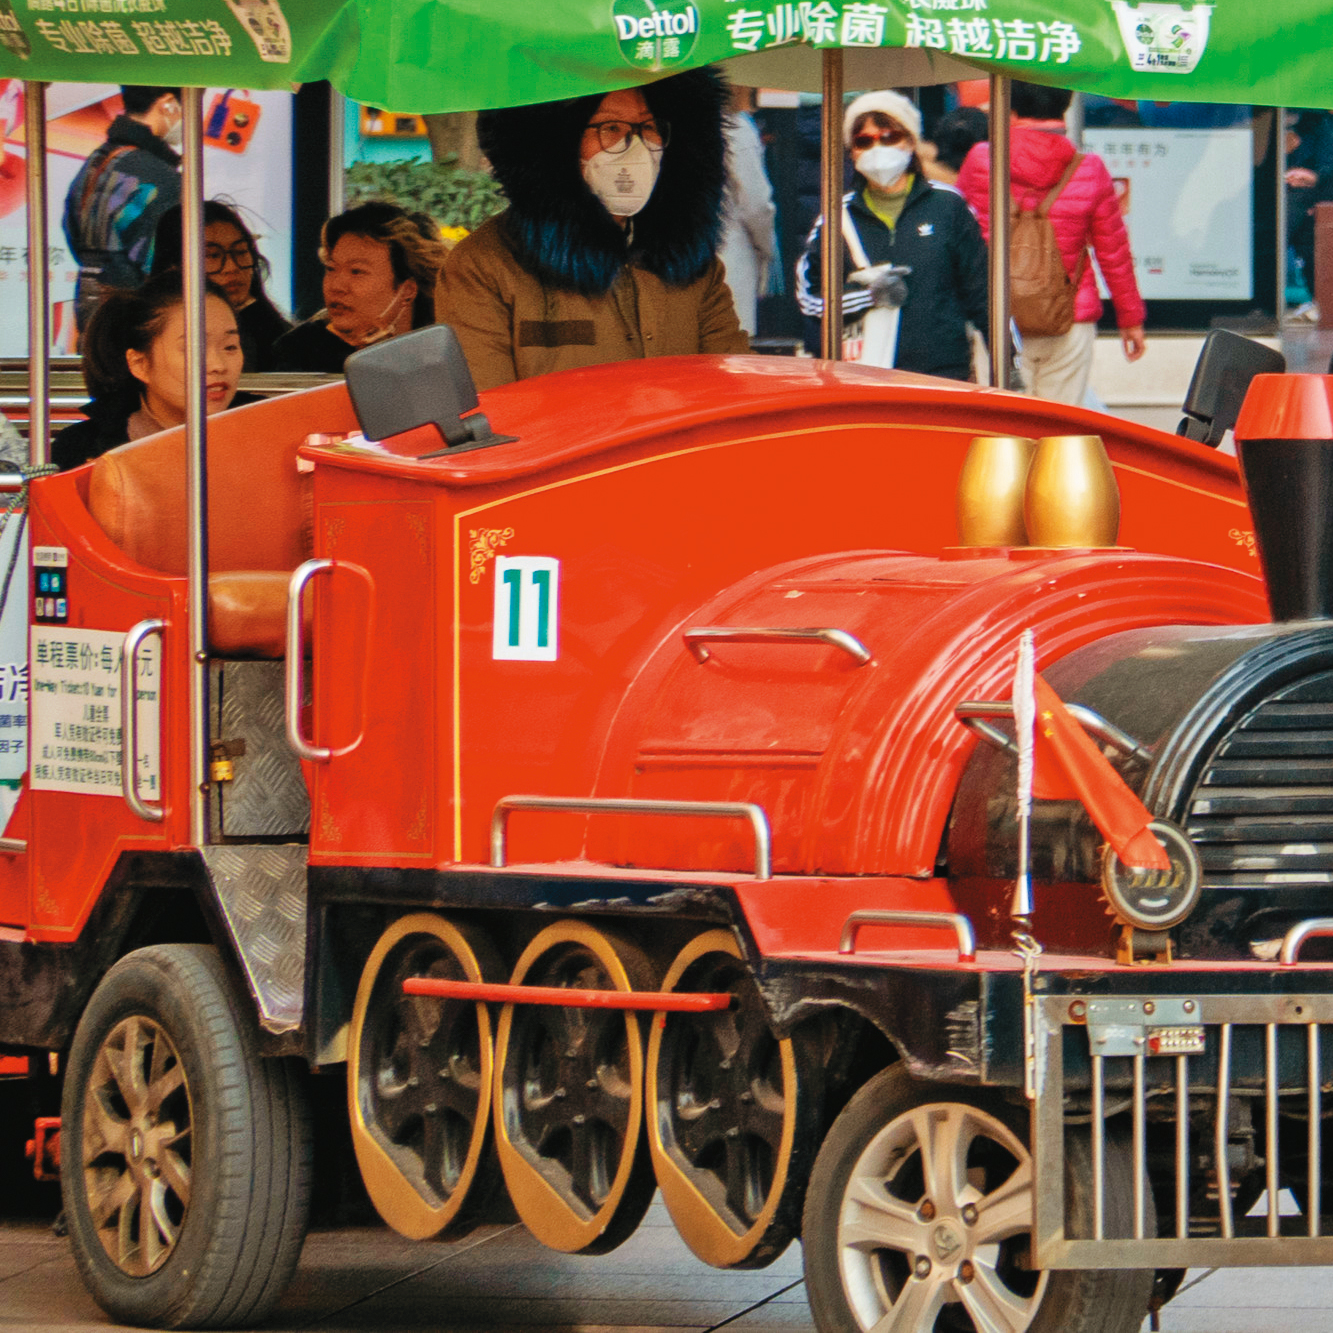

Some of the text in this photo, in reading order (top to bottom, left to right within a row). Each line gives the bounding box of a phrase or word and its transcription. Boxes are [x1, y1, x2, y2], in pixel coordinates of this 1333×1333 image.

[615, 6, 697, 42] Dettol
[726, 1, 1082, 64] 专业除菌 超越洁净
[502, 569, 550, 647] 11
